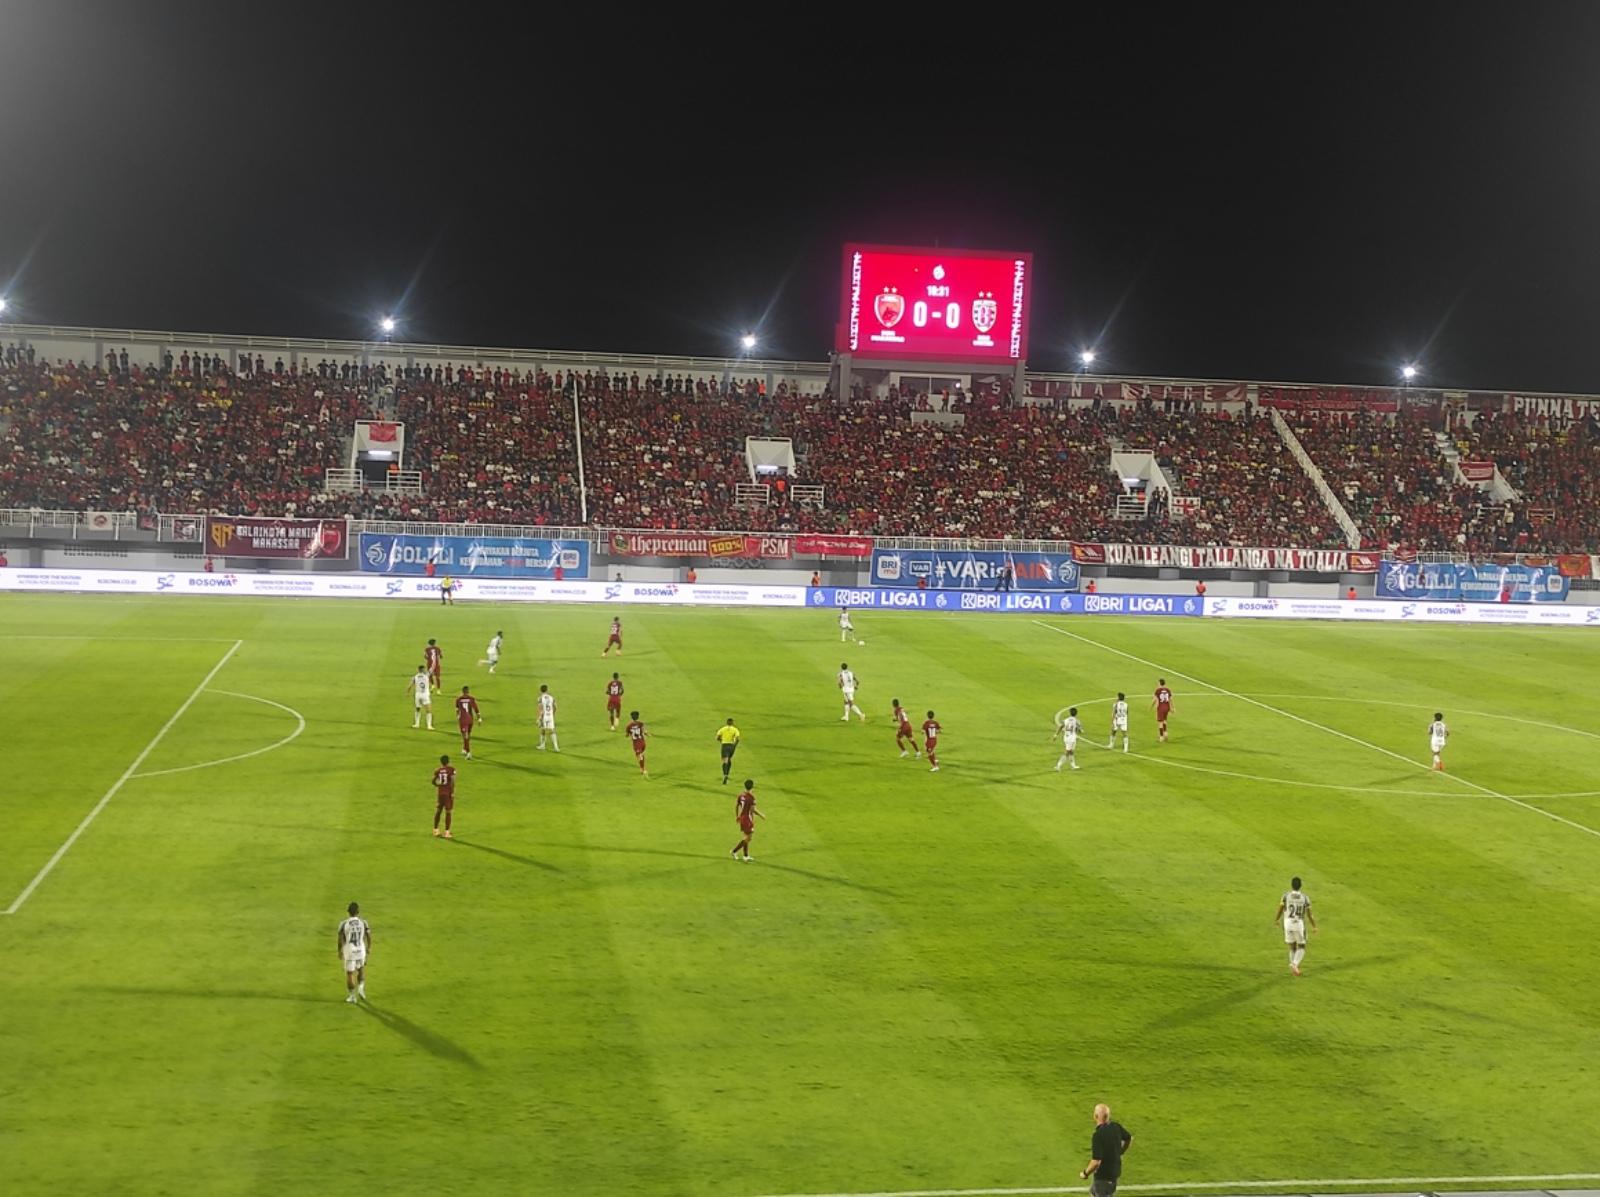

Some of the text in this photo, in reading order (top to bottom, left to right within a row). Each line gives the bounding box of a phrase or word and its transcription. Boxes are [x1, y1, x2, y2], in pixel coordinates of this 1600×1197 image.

[913, 301, 928, 327] 0
[946, 302, 960, 328] 0
[252, 538, 300, 549] MAKASSAR
[711, 540, 742, 553] 100%
[760, 538, 789, 554] PSM
[881, 561, 898, 569] BRI
[1196, 547, 1271, 569] TALLANGA
[1275, 549, 1294, 569] NA
[1298, 550, 1349, 572] TOALIA
[189, 578, 232, 587] BOSOWA
[416, 583, 457, 592] BOSOA
[634, 588, 674, 596] BOSOWA
[851, 591, 875, 605] BRI
[977, 595, 1001, 608] BRI
[1100, 598, 1124, 611] BRI
[1238, 603, 1274, 611] BOSOWA
[1427, 607, 1462, 615] BOSOWA
